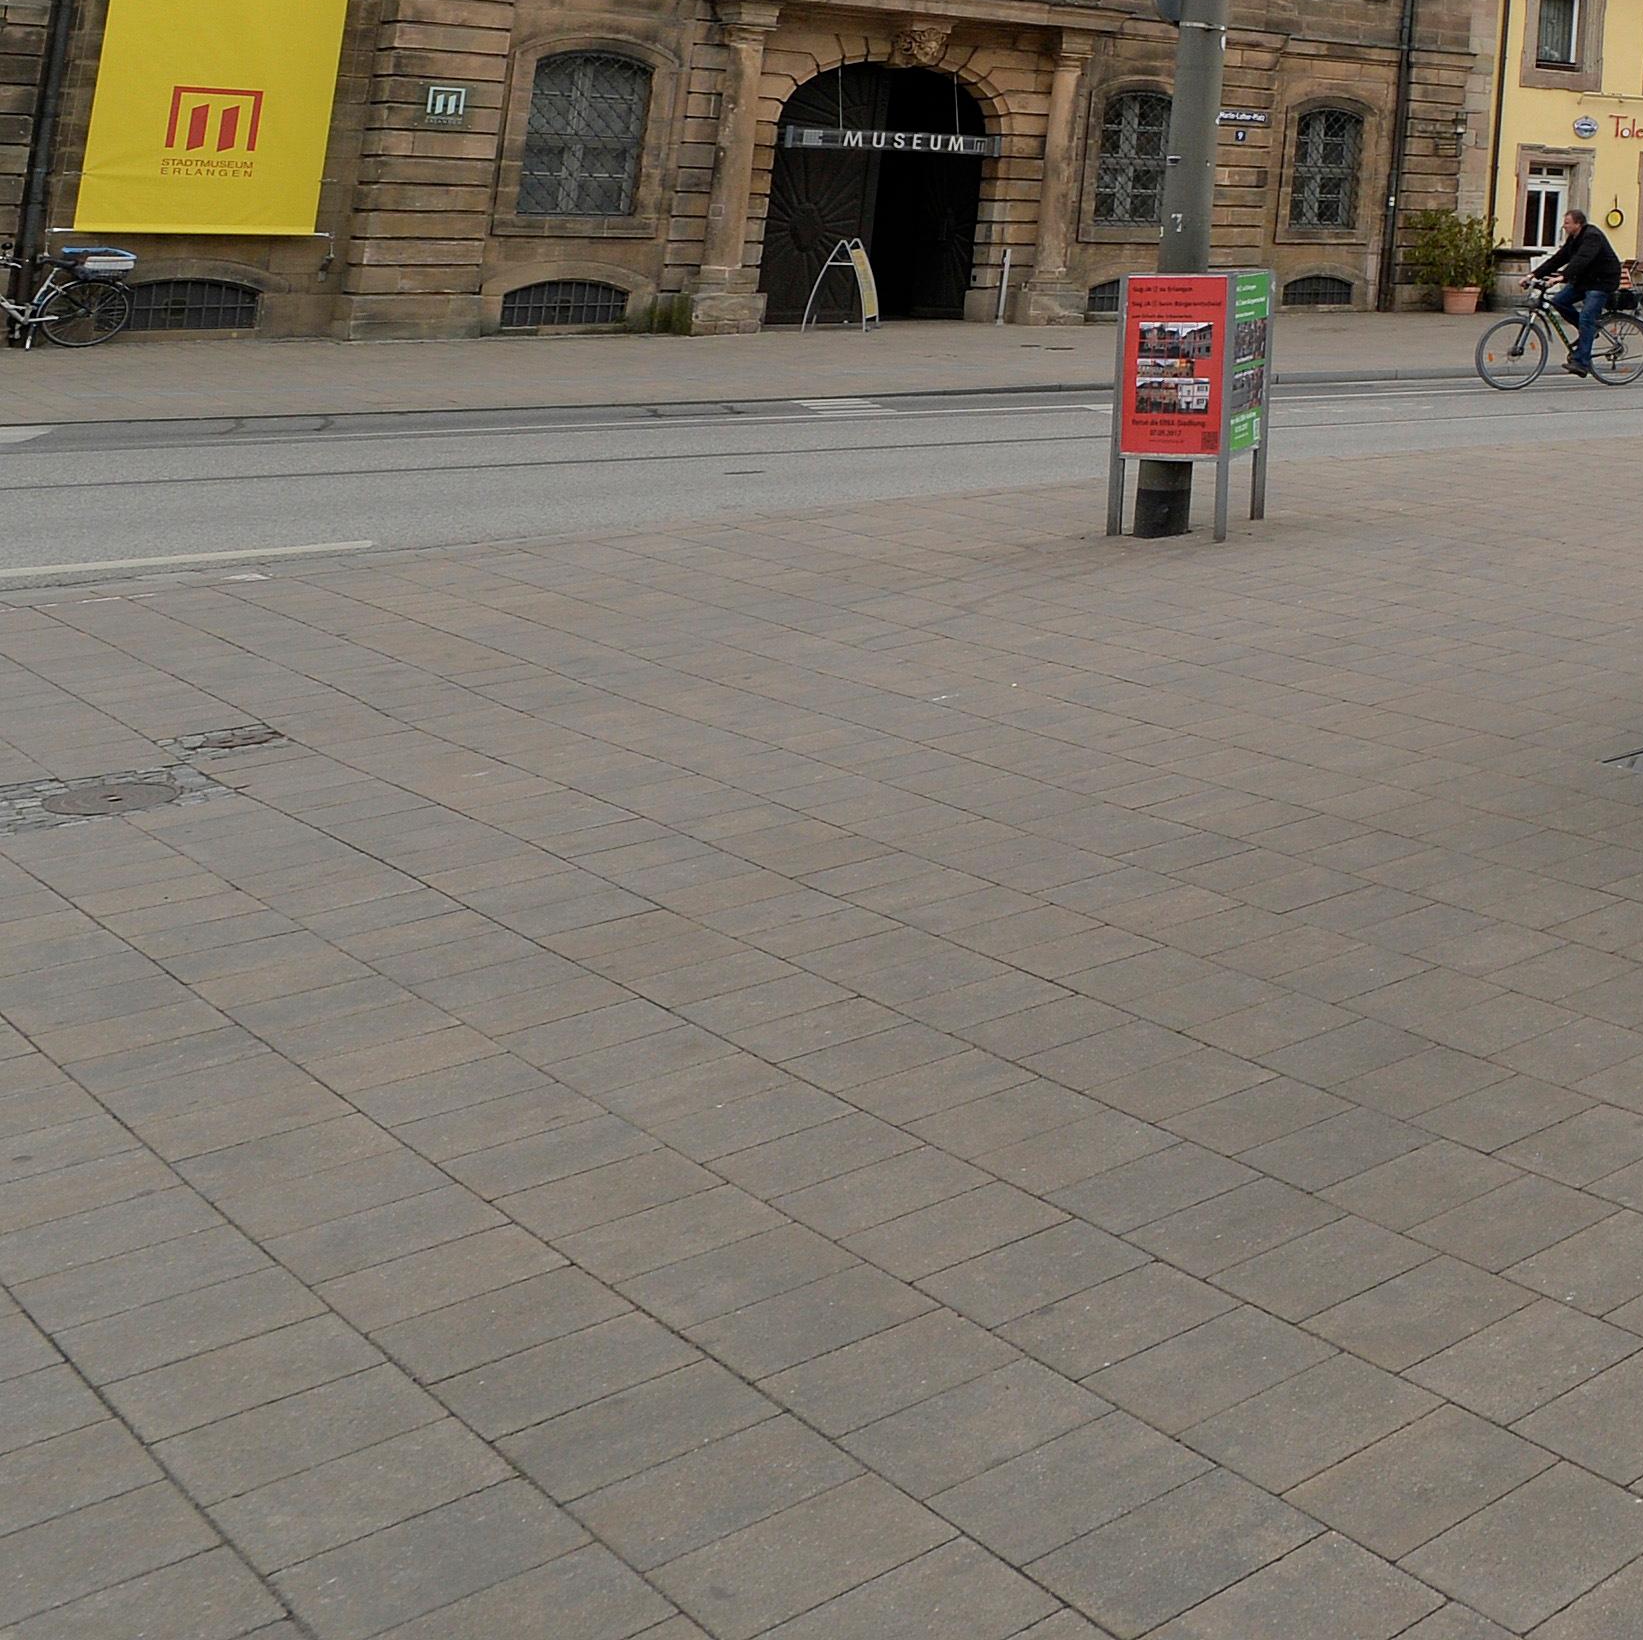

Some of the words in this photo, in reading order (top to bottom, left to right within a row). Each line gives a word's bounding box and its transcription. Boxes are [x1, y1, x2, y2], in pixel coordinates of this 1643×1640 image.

[842, 130, 964, 152] MUSEUM
[161, 158, 254, 168] STADTMUSEUM
[160, 167, 253, 177] ERLANGEN
